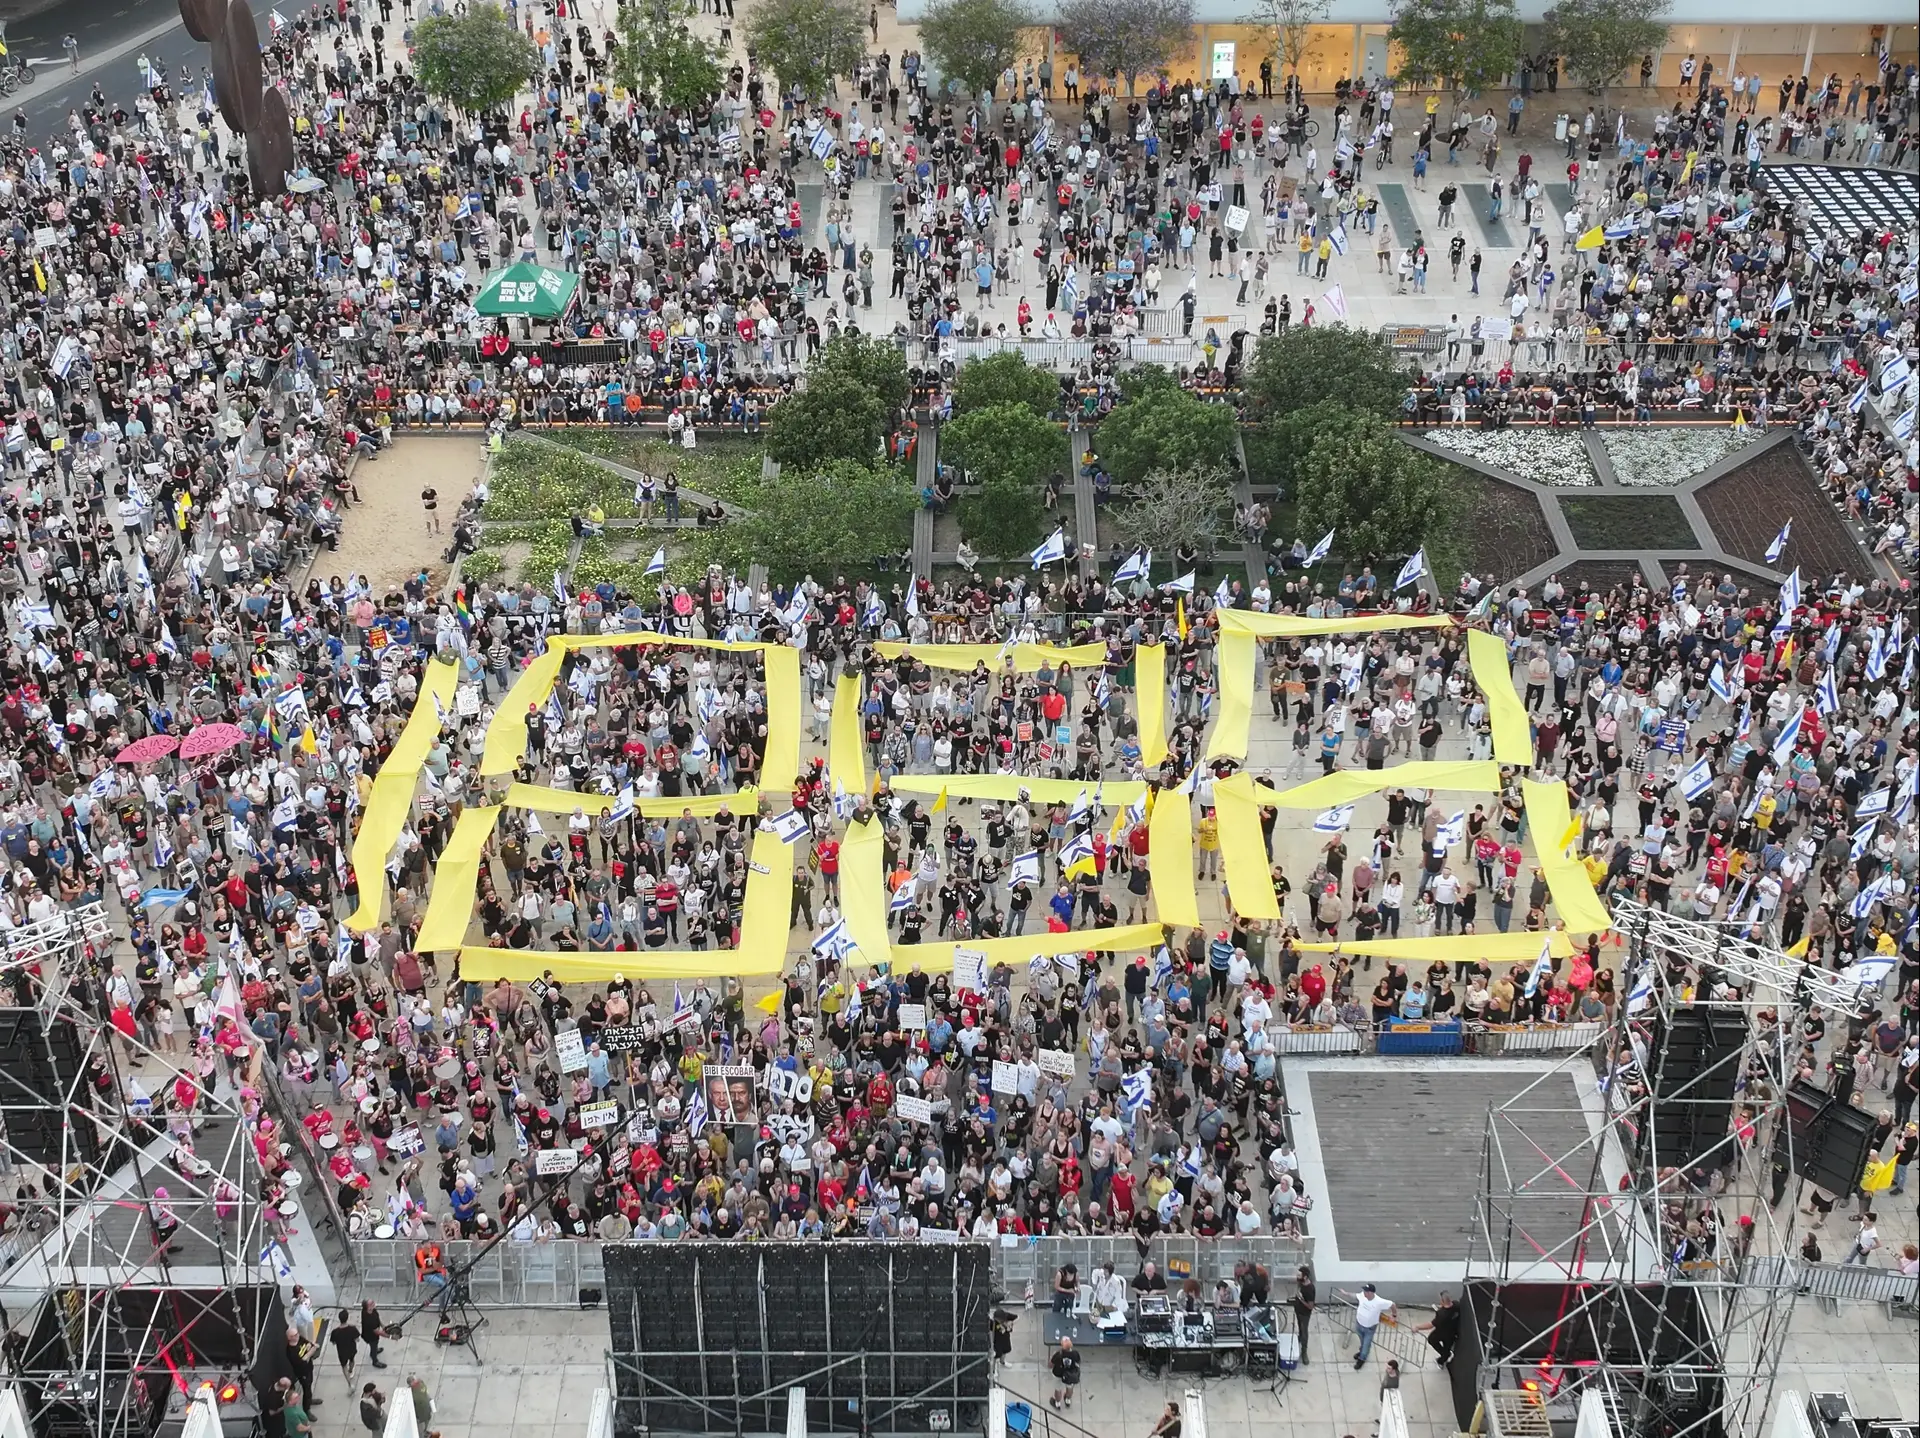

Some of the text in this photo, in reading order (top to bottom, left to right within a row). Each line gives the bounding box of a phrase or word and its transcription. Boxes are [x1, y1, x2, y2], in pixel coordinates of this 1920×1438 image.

[185, 730, 208, 753] שלום
[606, 1034, 645, 1043] המדינה
[605, 1042, 642, 1052] מעצמך
[704, 1066, 754, 1076] BIBI ESCOBAR
[583, 1110, 616, 1126] אין זמן
[766, 1114, 816, 1140] SAY
